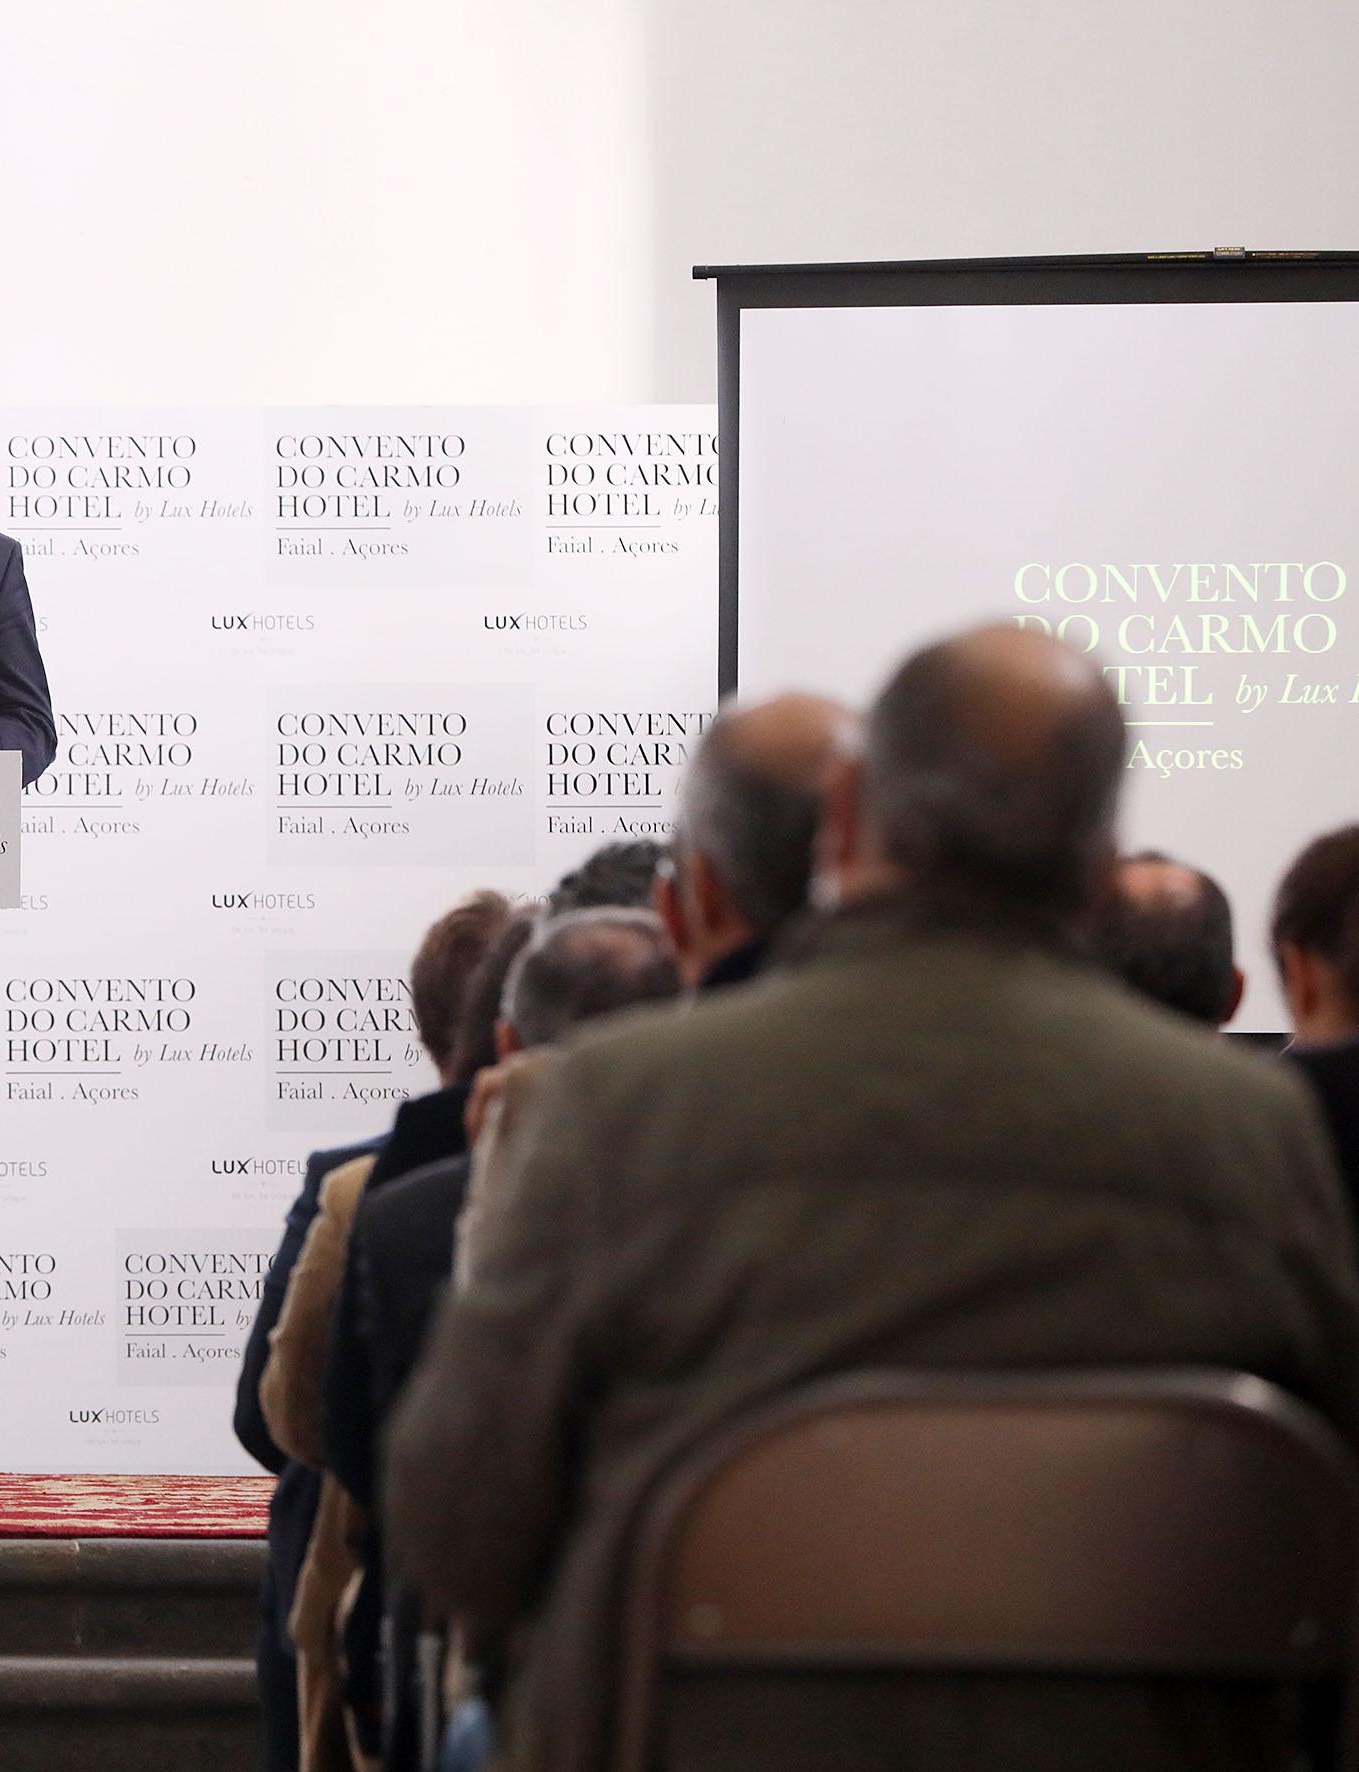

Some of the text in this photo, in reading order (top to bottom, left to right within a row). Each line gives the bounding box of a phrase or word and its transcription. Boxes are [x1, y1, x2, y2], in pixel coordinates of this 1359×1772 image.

[8, 436, 196, 458] CONVENTO
[277, 436, 465, 457] CONVENTO
[10, 466, 190, 488] DO CARMO
[279, 465, 459, 487] DO CARMO
[549, 464, 594, 485] DO
[10, 496, 253, 523] HOTEL by Lux Hotels
[279, 496, 522, 523] HOTEL by Lux Hotels
[549, 494, 660, 515] HOTEL
[674, 498, 692, 521] by
[19, 539, 139, 560] aial Açores
[278, 538, 408, 559] Faial Açores
[549, 536, 678, 557] Faial Açores
[1014, 562, 1346, 603] CONVENTO
[1118, 614, 1337, 654] CARMO
[1103, 666, 1214, 705] TEL
[1235, 675, 1268, 713] by
[1278, 674, 1339, 704] Lux
[58, 713, 197, 737] NVENTO
[278, 714, 466, 736] CONVENTO
[546, 712, 713, 736] CONVENT
[69, 744, 191, 765] CARMO
[279, 744, 461, 766] DO CARMO
[548, 744, 595, 765] DO
[1127, 740, 1244, 778] Açores
[135, 778, 153, 801] by
[161, 778, 191, 795] Lux
[200, 778, 254, 795] Hotels
[280, 774, 522, 801] HOTEL by Lux Hotels
[549, 773, 661, 795] HOTEL
[21, 817, 139, 838] aial Açores
[279, 816, 409, 838] Faial Açores
[549, 816, 592, 833] Faial
[6, 979, 195, 1001] CONVENTO
[276, 978, 413, 1002] CONVEN
[8, 1009, 190, 1031] DO CARMO
[278, 1009, 325, 1031] DO
[8, 1040, 252, 1067] HOTEL by Lux Hotels
[279, 1039, 423, 1067] HOTEL by
[8, 1082, 138, 1105] Faial Açores
[279, 1082, 410, 1104] Faial Açores
[125, 1280, 266, 1300] DO CARM
[2, 1310, 18, 1331] by
[24, 1310, 53, 1326] Lux
[59, 1310, 106, 1326] Hotels
[125, 1305, 252, 1330] HOTEL by
[126, 1343, 241, 1363] Faial Açores
